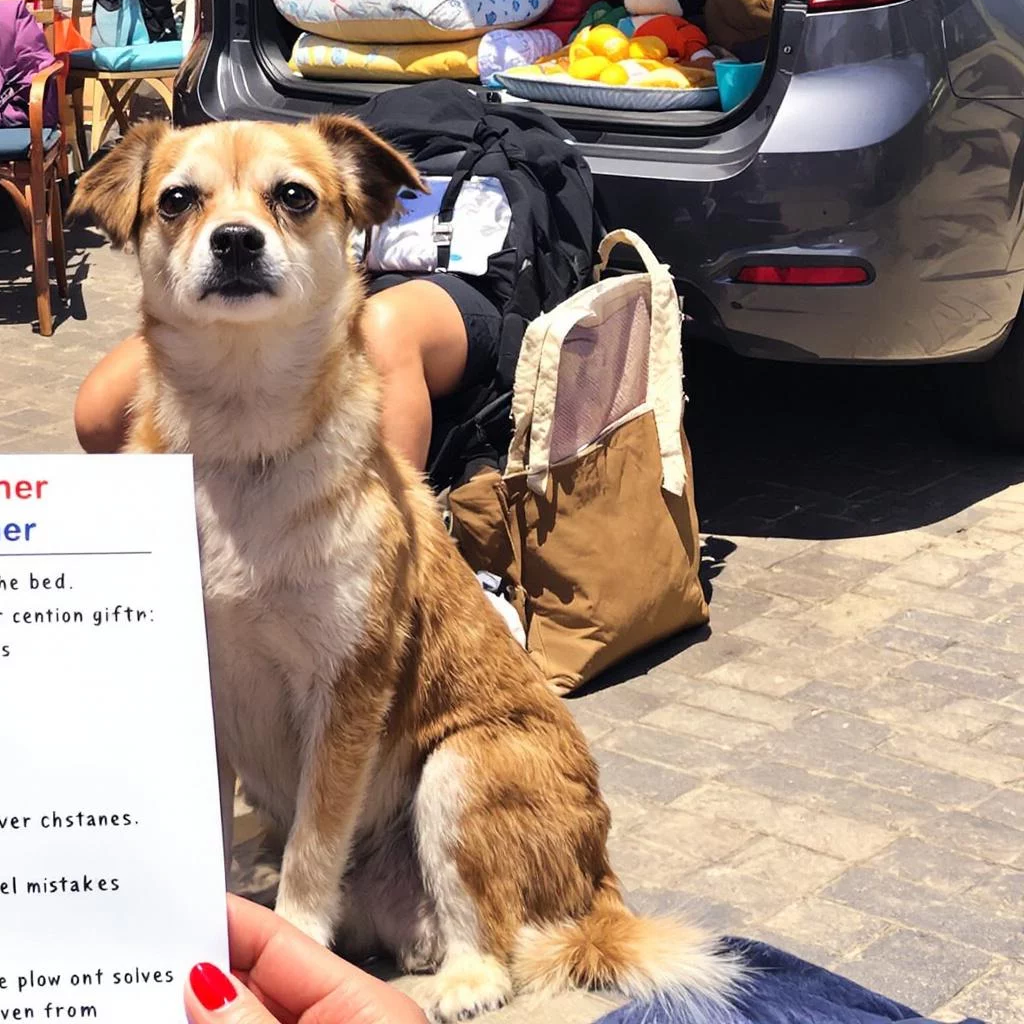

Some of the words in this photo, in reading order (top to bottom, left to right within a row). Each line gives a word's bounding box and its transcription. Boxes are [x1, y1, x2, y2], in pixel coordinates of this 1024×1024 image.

[29, 572, 74, 590] bed.
[12, 607, 83, 624] cention
[40, 810, 139, 829] chstanes.
[26, 874, 120, 894] mistakes
[17, 969, 61, 993] plow
[70, 968, 104, 987] ont
[112, 966, 174, 985] solves
[43, 1002, 97, 1019] from
